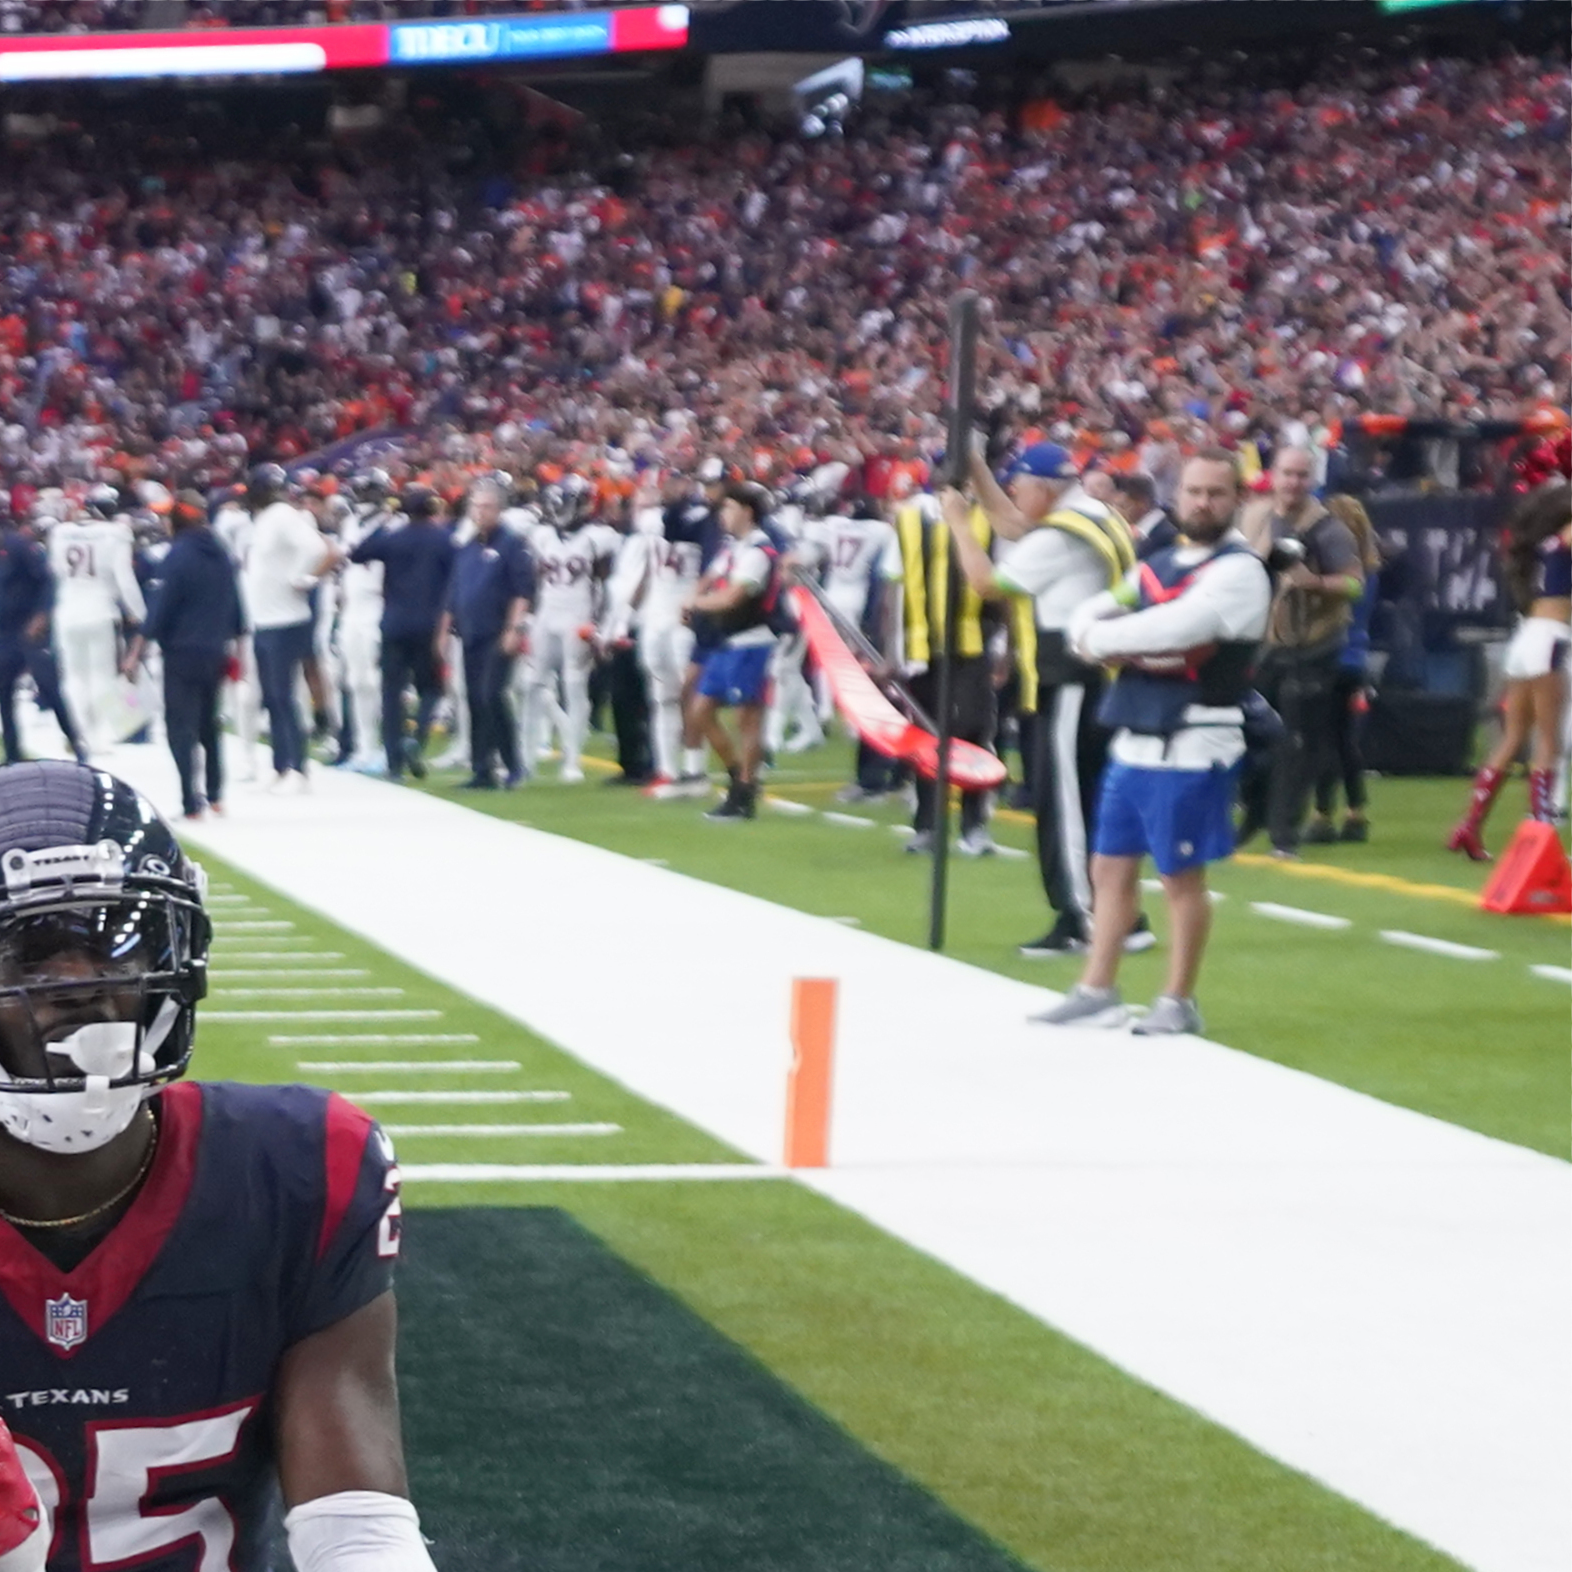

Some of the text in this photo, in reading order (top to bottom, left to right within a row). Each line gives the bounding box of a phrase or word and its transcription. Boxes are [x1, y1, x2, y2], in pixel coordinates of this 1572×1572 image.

[66, 543, 97, 577] 91
[52, 1318, 82, 1337] NFL
[5, 1387, 130, 1409] TEXANS
